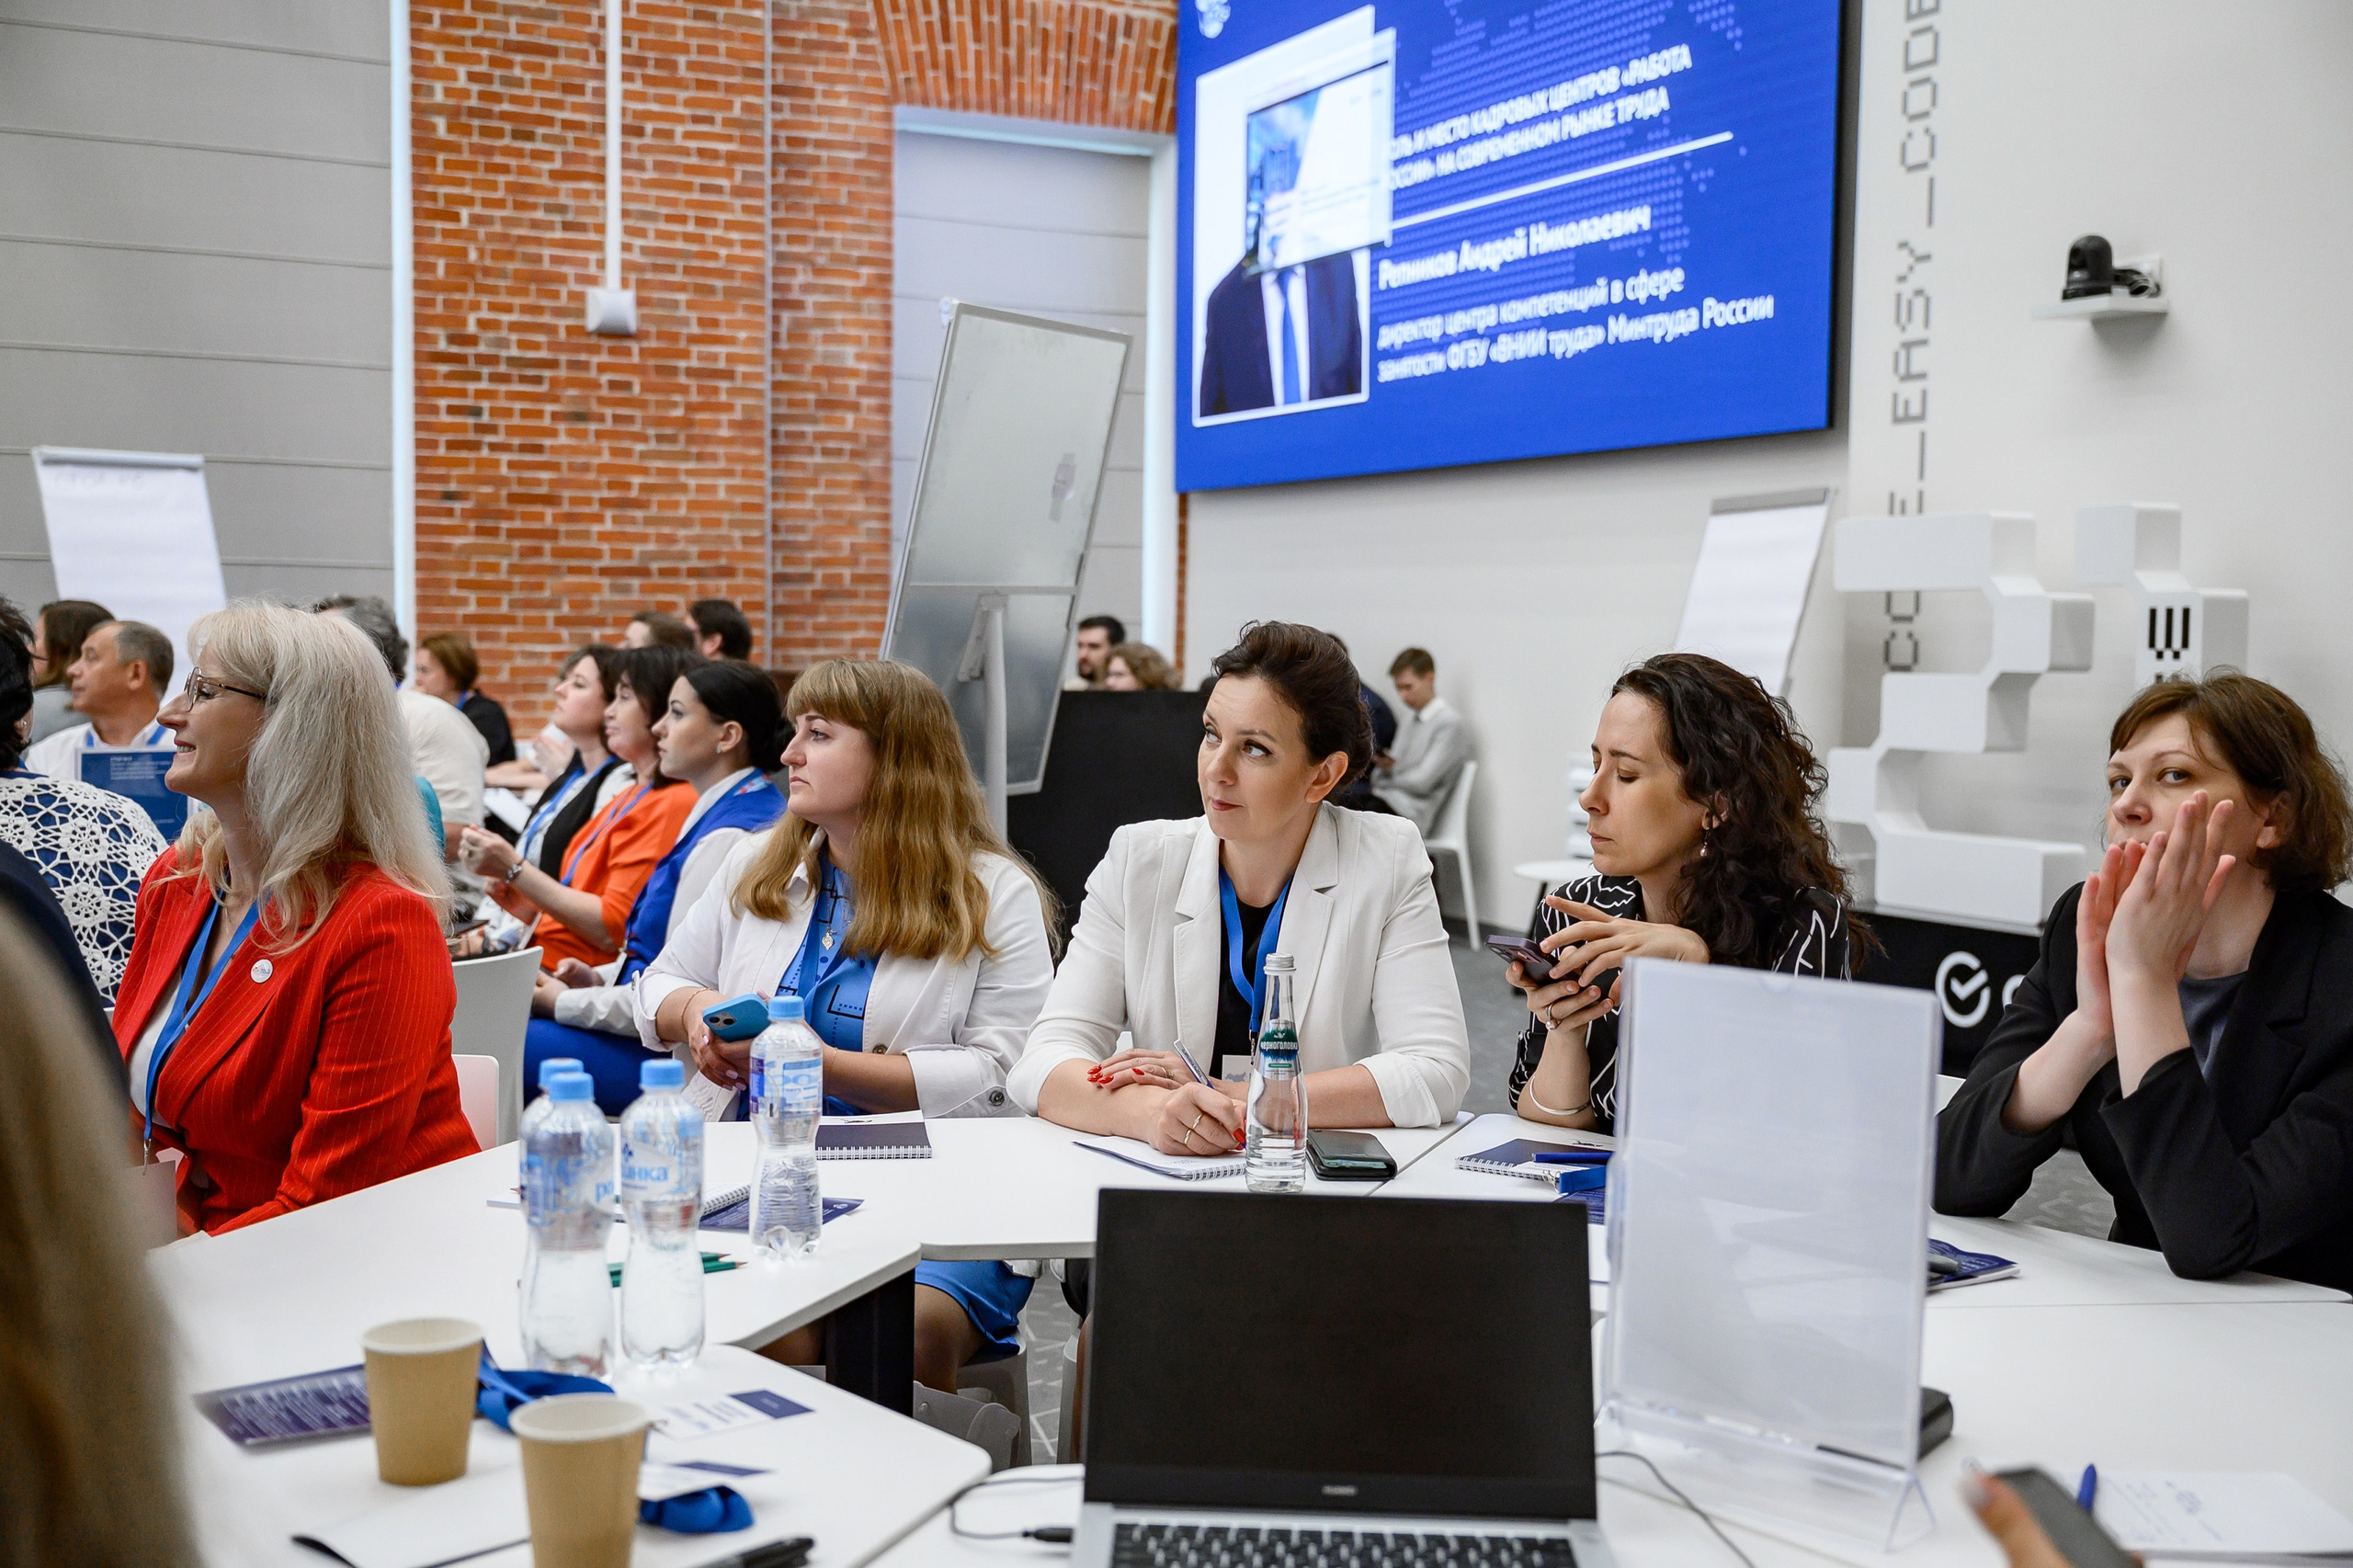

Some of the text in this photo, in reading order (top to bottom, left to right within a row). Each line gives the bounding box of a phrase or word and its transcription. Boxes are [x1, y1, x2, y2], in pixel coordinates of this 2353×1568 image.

[1426, 114, 1471, 150] МЕСТО
[1471, 88, 1550, 136] КАДРОВЫХ
[1549, 65, 1621, 113] ЦЕНТРОВ
[1620, 43, 1693, 86] «РАБОТА
[1456, 117, 1561, 172] СОВРЕМЕННОМ
[1561, 101, 1616, 142] РЫНКЕ
[1615, 85, 1671, 124] ТРУДА
[1458, 226, 1529, 273] Андрей
[1529, 204, 1651, 256] Николаевич
[1445, 303, 1498, 335] центра
[1499, 276, 1609, 324] компетенций
[1610, 278, 1624, 304] в
[1625, 267, 1686, 305] сфере
[1547, 324, 1607, 360] труда»
[1608, 312, 1699, 345] Минтруда
[1702, 294, 1775, 329] России
